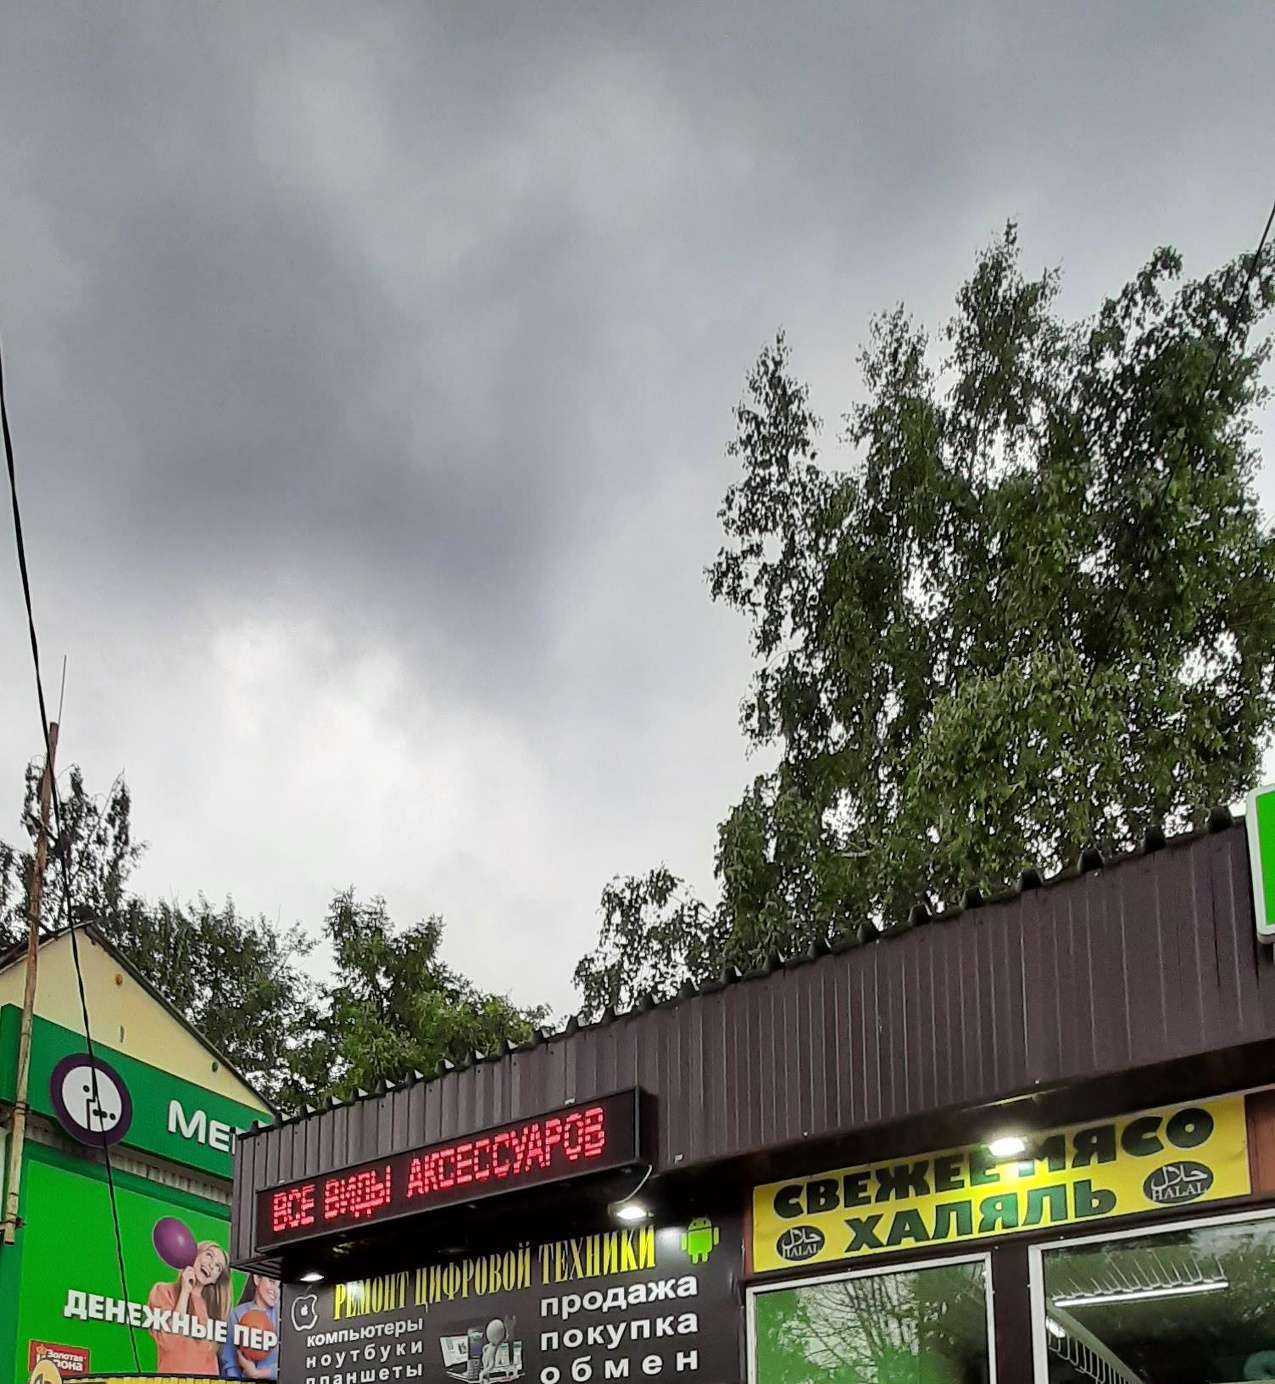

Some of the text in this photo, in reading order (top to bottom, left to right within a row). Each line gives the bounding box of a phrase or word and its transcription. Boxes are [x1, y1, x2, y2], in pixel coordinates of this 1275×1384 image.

[273, 1107, 605, 1232] ВСЕ ВИДЫ АКСЕССУАРОВ
[1151, 1165, 1208, 1190] حلال
[1152, 1182, 1207, 1200] HALAL
[845, 1179, 1118, 1253] ХАЛЯЛЬ
[333, 1225, 656, 1321] РЕМОНТ ЦИФРОВОЙ ТЕХНИКИ
[541, 1273, 698, 1319] продажа
[64, 1289, 278, 1351] ДЕНЕЖНЫЕ ПЕР
[307, 1317, 423, 1348] компьютеры
[541, 1309, 698, 1352] покупка
[306, 1340, 423, 1370] ноутбуки
